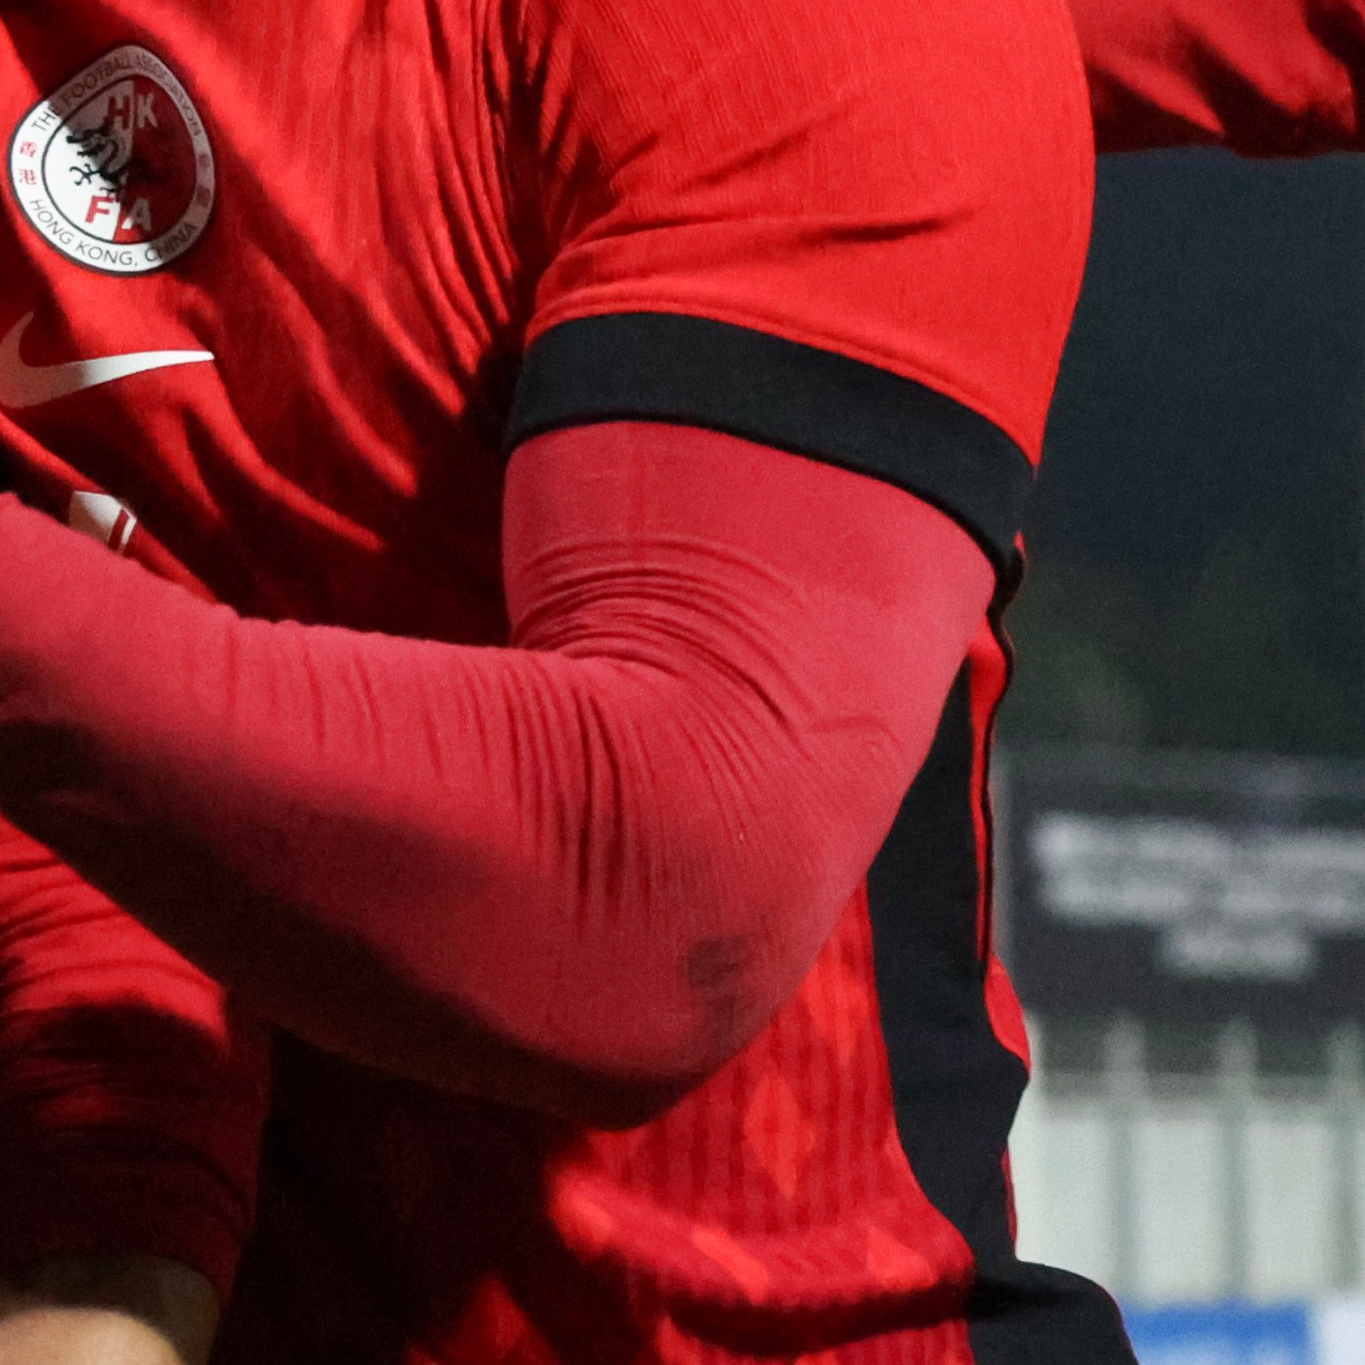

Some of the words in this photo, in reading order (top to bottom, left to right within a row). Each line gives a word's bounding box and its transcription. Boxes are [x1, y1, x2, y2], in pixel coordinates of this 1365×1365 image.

[108, 92, 158, 129] HK
[84, 195, 153, 232] FA
[29, 198, 75, 244] HONG
[76, 240, 138, 268] KONG,
